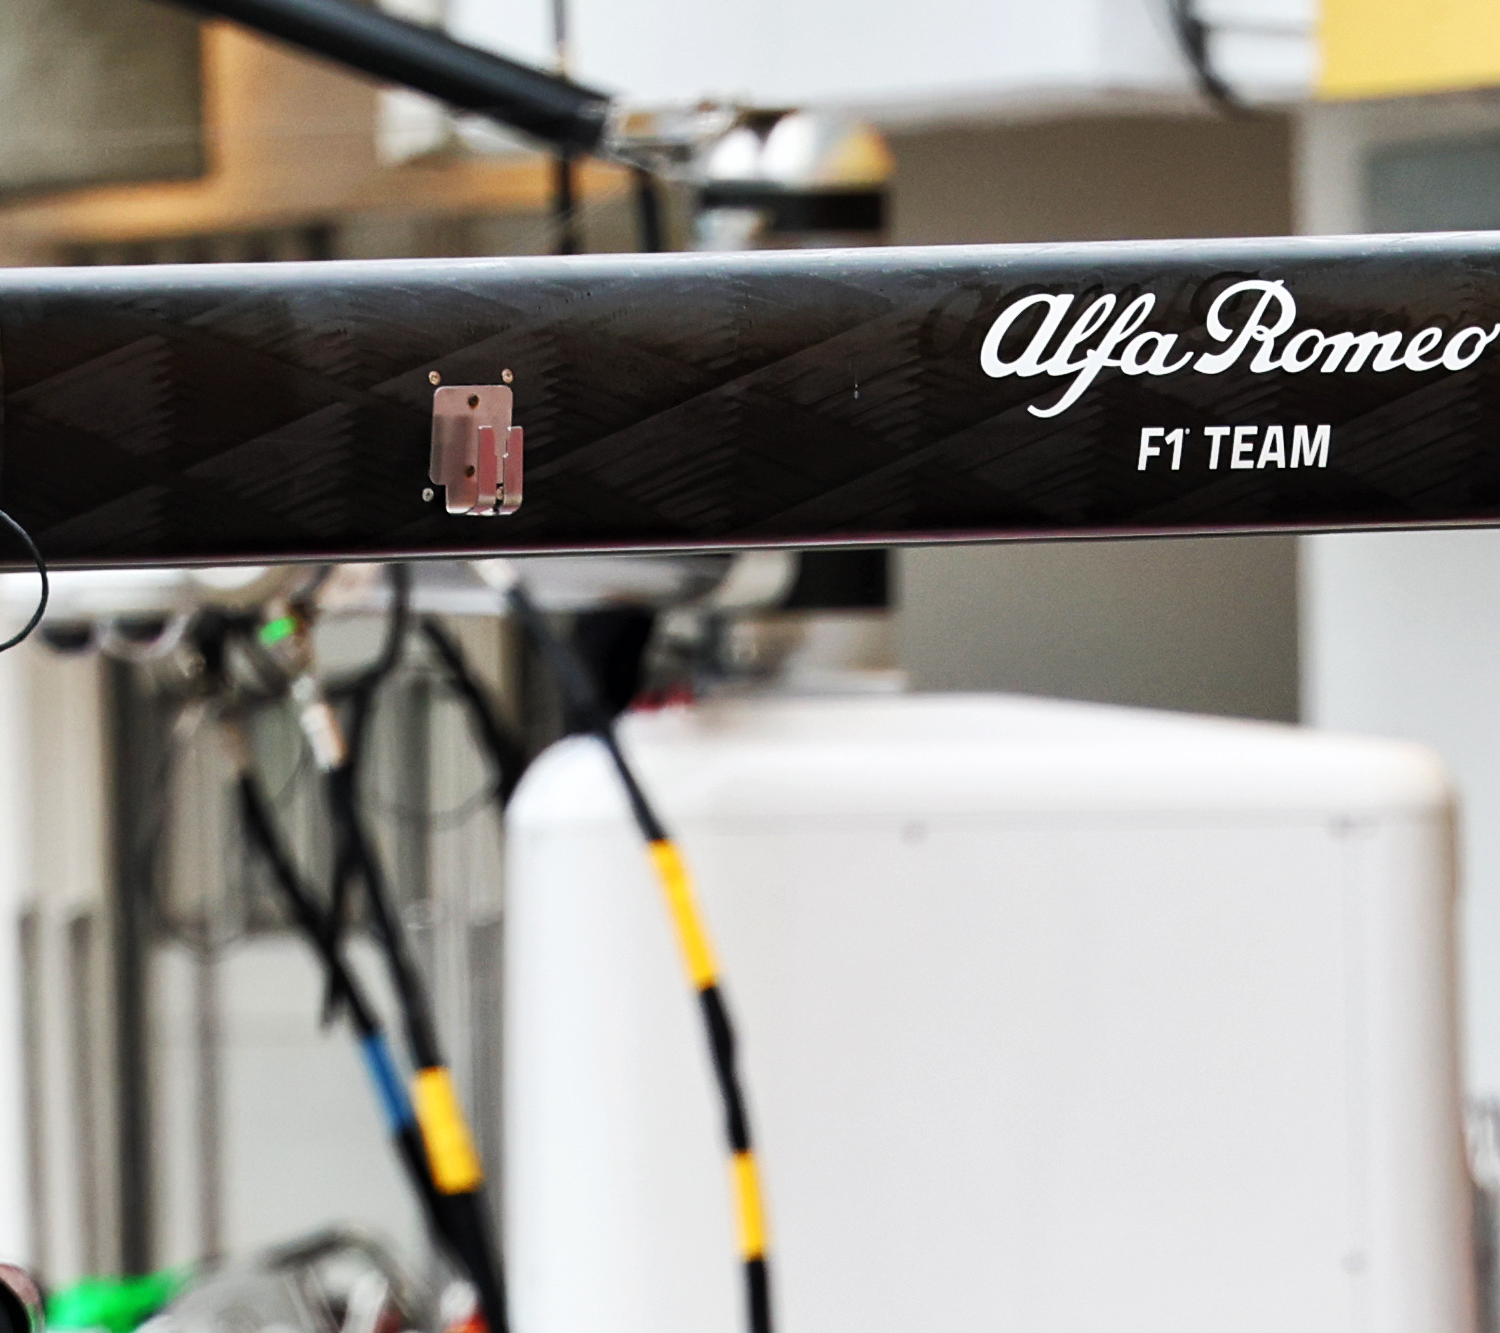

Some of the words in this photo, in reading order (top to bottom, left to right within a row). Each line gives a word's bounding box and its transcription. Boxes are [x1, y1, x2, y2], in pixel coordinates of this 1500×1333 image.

[979, 292, 1192, 418] Alfa
[1192, 278, 1500, 376] Romeo
[1137, 427, 1190, 471] F1
[1204, 424, 1331, 470] TEAM
